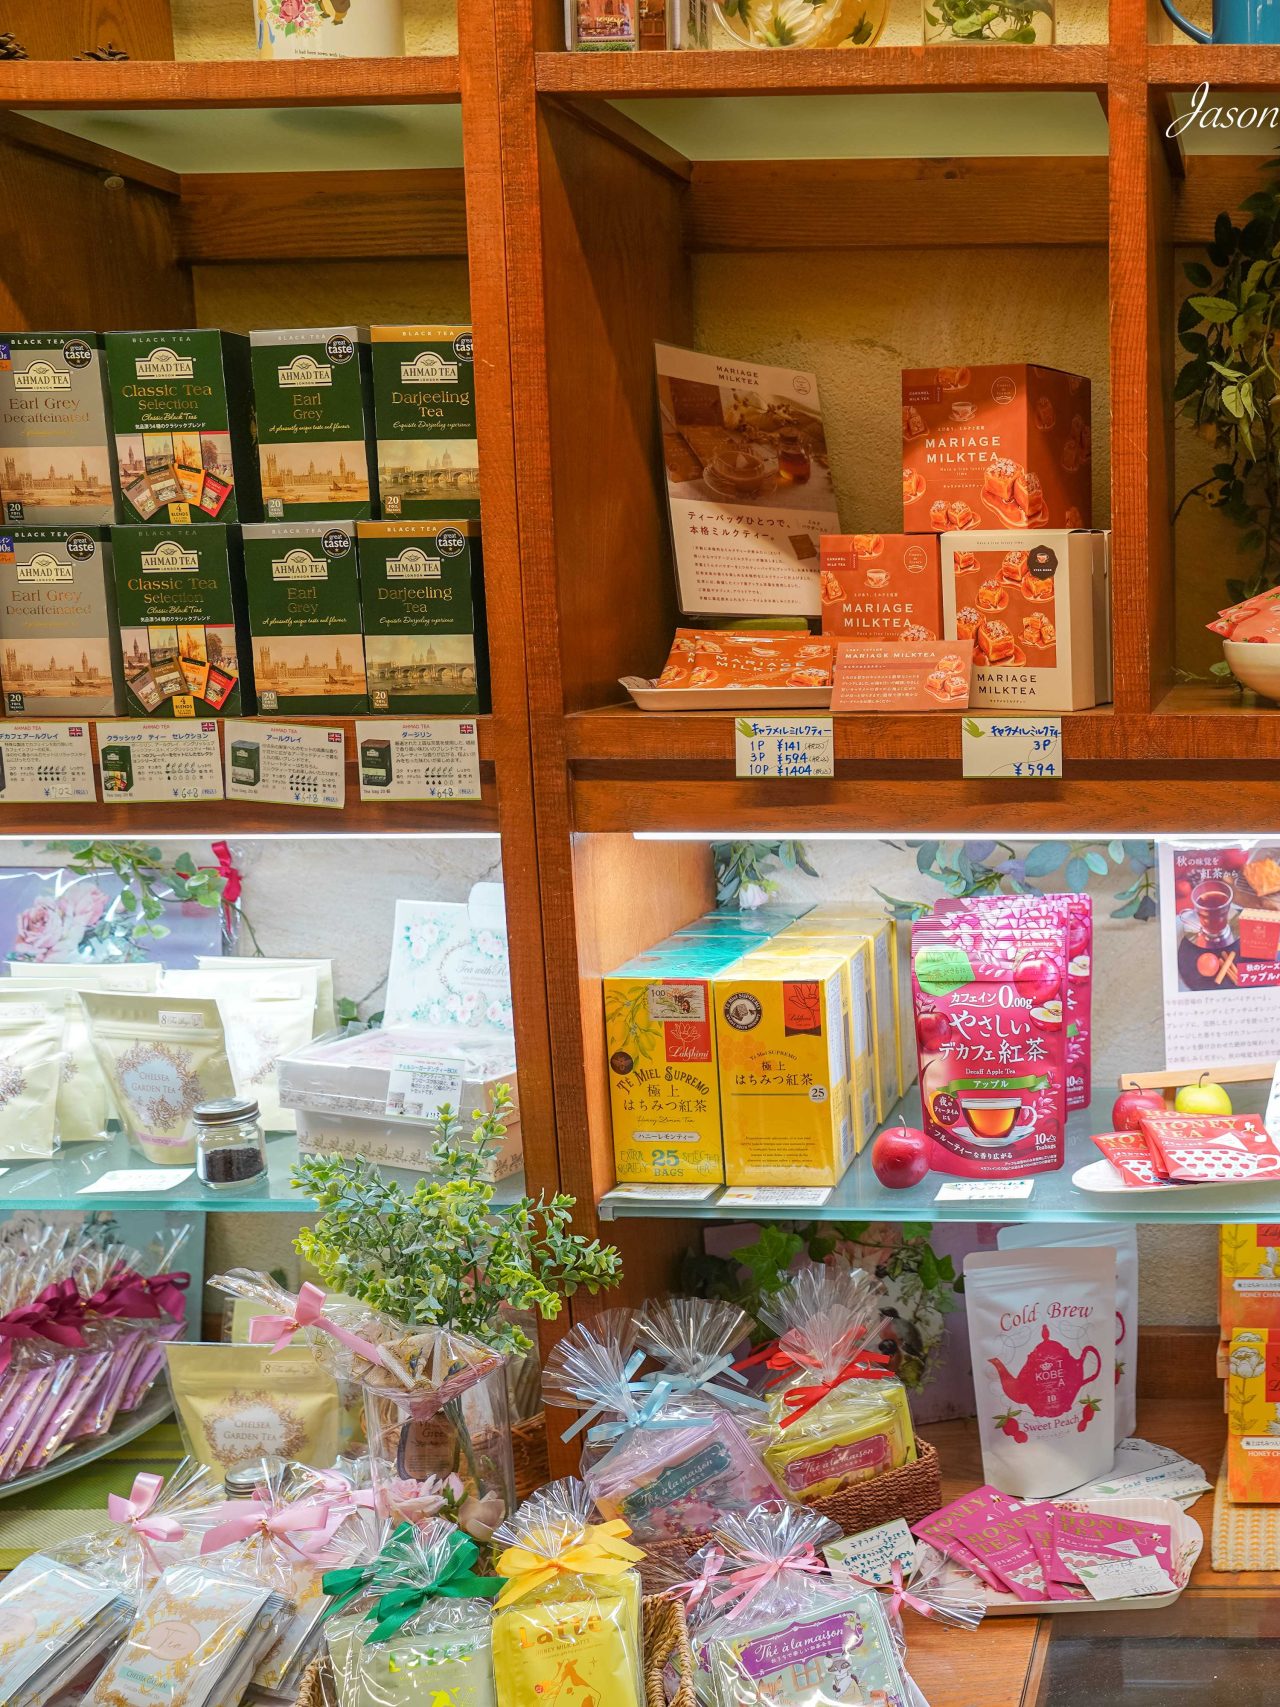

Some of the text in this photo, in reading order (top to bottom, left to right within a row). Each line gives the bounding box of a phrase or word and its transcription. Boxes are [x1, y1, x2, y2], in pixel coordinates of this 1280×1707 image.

[138, 363, 191, 373] AHMAD TEA
[403, 366, 456, 377] AHMAD TEA
[716, 365, 759, 378] MARIAGE
[16, 374, 69, 385] AHMAD TEA
[281, 371, 330, 381] AHMAD TEA
[718, 374, 759, 386] MILKTEA
[121, 384, 212, 398] Classic Tea
[392, 391, 469, 406] Darjeeling
[418, 407, 444, 417] Tea
[925, 436, 1001, 449] MARIAGE
[927, 452, 998, 464] MILKTEA
[688, 511, 791, 529] ティーバッグひとつで、
[690, 525, 775, 541] 本格ミルクティー。
[144, 557, 197, 566] AHMAD TEA
[19, 568, 71, 577] AHMAD TEA
[274, 564, 326, 574] AHMAD TEA
[388, 564, 439, 573] AHMAD TEA
[128, 578, 183, 591] Classic
[287, 587, 317, 600] Earl
[378, 586, 452, 602] Darjeeling
[404, 603, 428, 613] Tea
[842, 603, 914, 613] MARIAGE
[844, 618, 911, 628] MILKTEA
[977, 673, 1037, 683] MARIAGE
[263, 692, 275, 701] 20
[374, 691, 386, 700] 20
[978, 686, 1036, 696] MILKTEA
[9, 694, 21, 702] 20
[752, 723, 831, 736] キャラメルミルクティー
[991, 725, 1062, 738] キャラメルミルクティー
[266, 734, 302, 743] アールグレイ
[777, 739, 800, 751] ¥141
[1033, 739, 1051, 751] 3P
[778, 753, 808, 764] ¥594
[750, 764, 769, 775] 10P
[1013, 763, 1056, 776] ¥594
[1176, 856, 1220, 866] 秋の味覚を
[1200, 868, 1239, 879] 紅茶から
[951, 992, 996, 1004] カフェイン
[950, 1011, 1030, 1040] やさしい
[939, 1039, 1048, 1064] デカフェ紅茶
[762, 1061, 786, 1071] 極上
[139, 1072, 170, 1082] CHELSEA
[665, 1065, 710, 1096] SUPREMO
[735, 1073, 814, 1086] はちみつ紅茶
[131, 1082, 177, 1094] GARDEN TEA
[973, 1080, 1008, 1088] アップル
[647, 1084, 680, 1098] 極上
[811, 1088, 825, 1098] 25
[623, 1099, 707, 1113] はちみつ紅茶
[1151, 1119, 1237, 1130] HONEY
[637, 1133, 694, 1141] ハニーレモンティー
[652, 1150, 679, 1167] 25
[1000, 1301, 1094, 1332] Cold Brew
[1035, 1370, 1064, 1381] KOBE
[233, 1419, 271, 1429] CHELSEA
[1023, 1415, 1080, 1433] Sweet Peach
[223, 1430, 278, 1442] GARDEN TEA
[921, 1497, 988, 1536] HONEY
[968, 1510, 1041, 1545] HONEY
[1059, 1514, 1150, 1536] HONEY
[1060, 1523, 1105, 1540] TEA
[975, 1535, 1019, 1553] TEA
[519, 1615, 602, 1649] Latte
[755, 1629, 844, 1663] Thé maison
